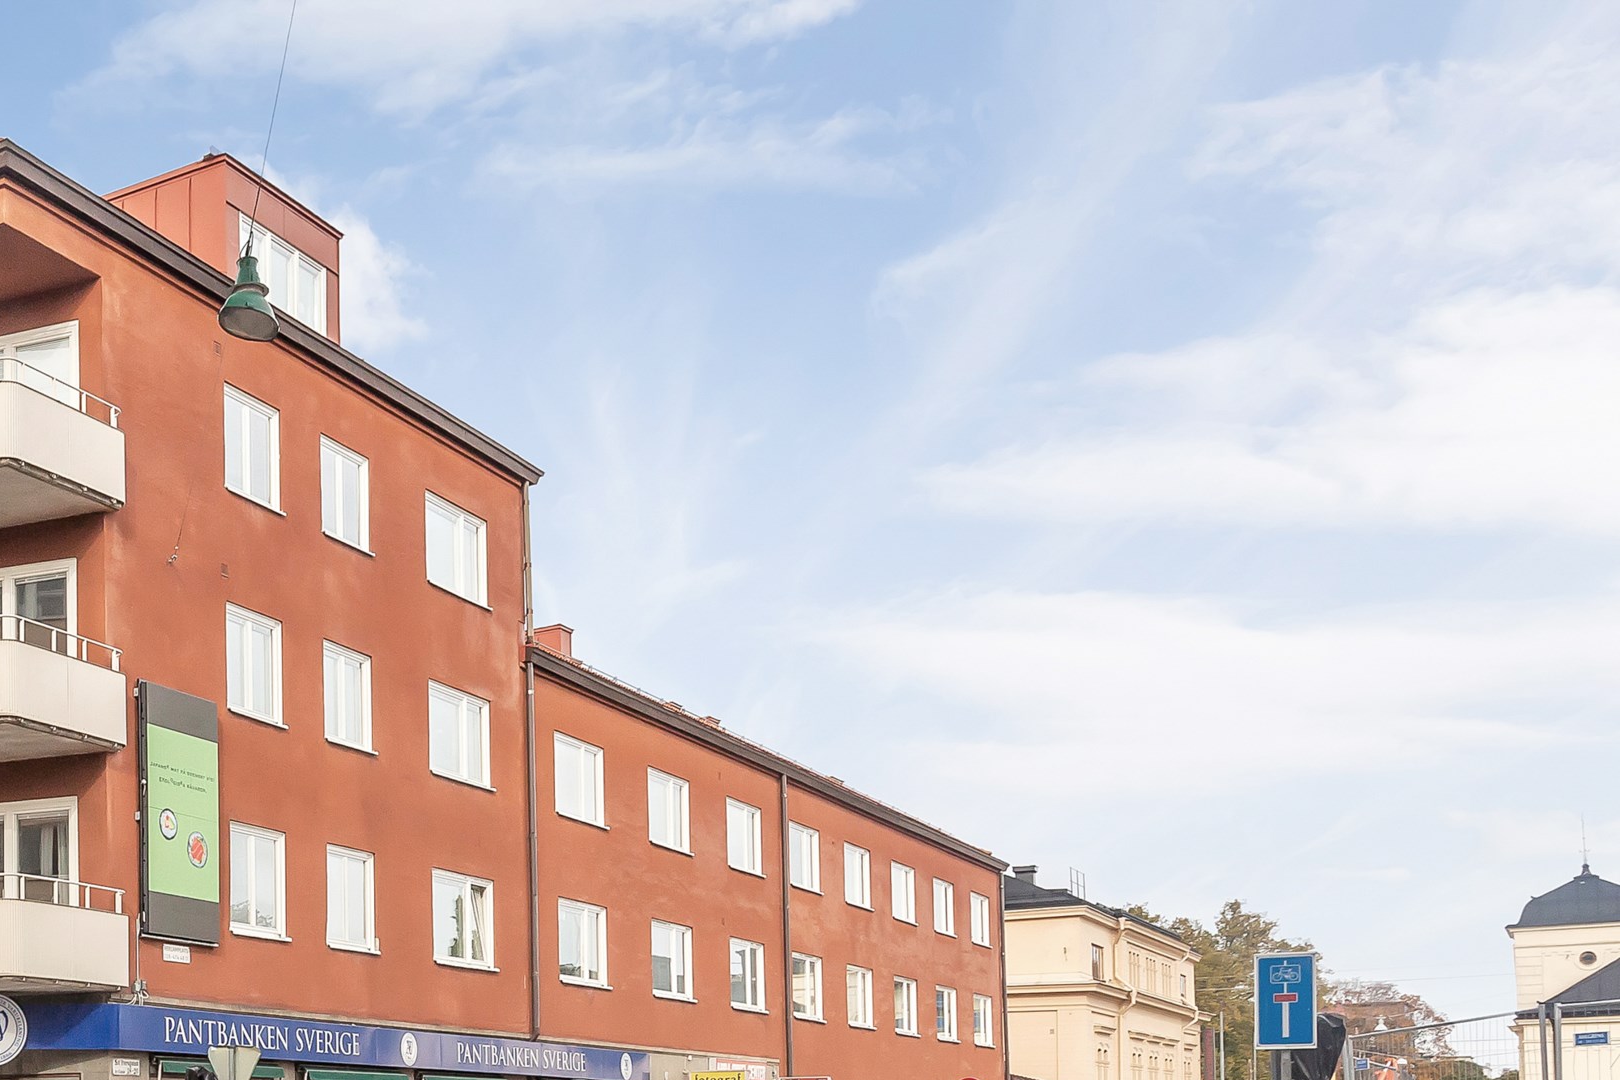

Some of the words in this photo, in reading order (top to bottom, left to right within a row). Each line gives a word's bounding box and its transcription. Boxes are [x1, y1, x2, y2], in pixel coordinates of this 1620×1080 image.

[164, 1016, 288, 1050] PANTBANKEN
[295, 1028, 360, 1056] SVERIGE
[457, 1041, 539, 1068] PANTBANKEN
[543, 1050, 586, 1072] SVERIGE
